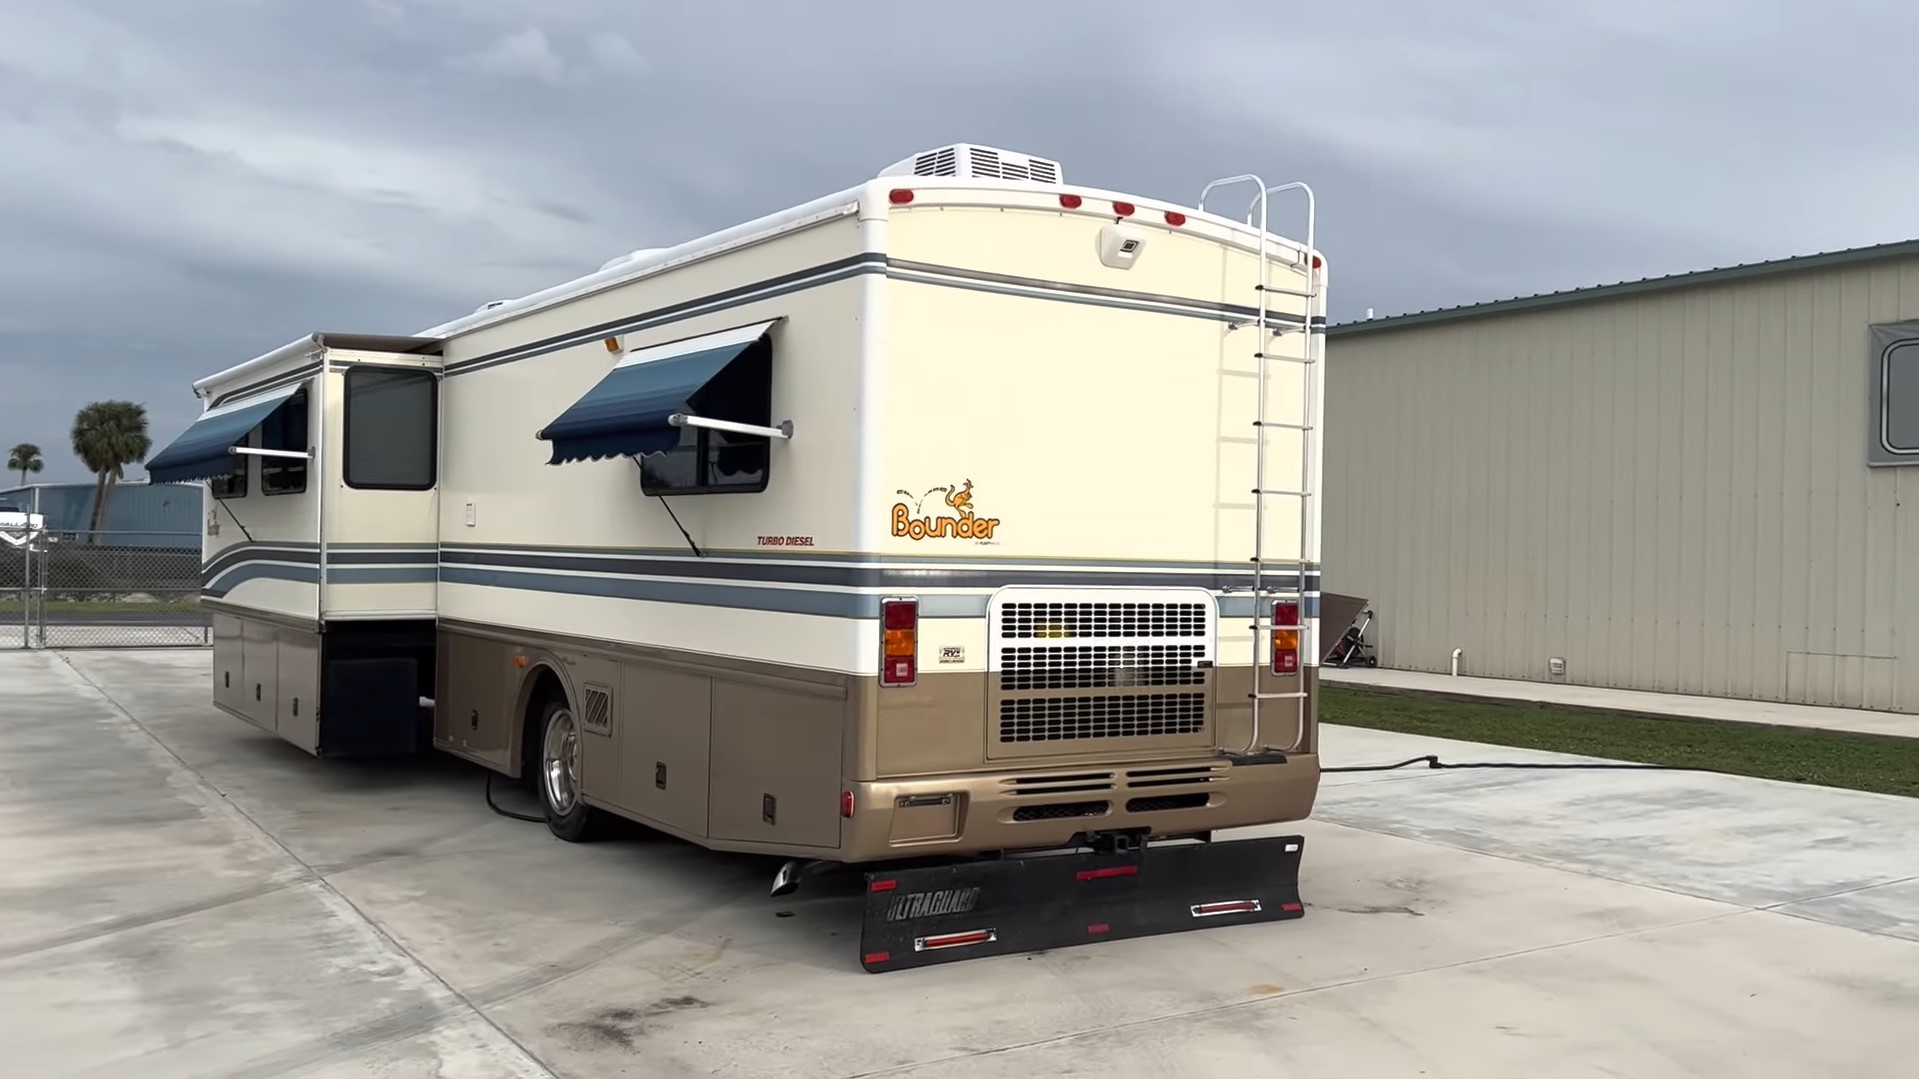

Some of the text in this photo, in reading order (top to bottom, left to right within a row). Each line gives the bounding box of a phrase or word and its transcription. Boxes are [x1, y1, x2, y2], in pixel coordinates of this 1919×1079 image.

[891, 502, 1000, 540] Bounder
[757, 536, 815, 546] TURBO DIESEL
